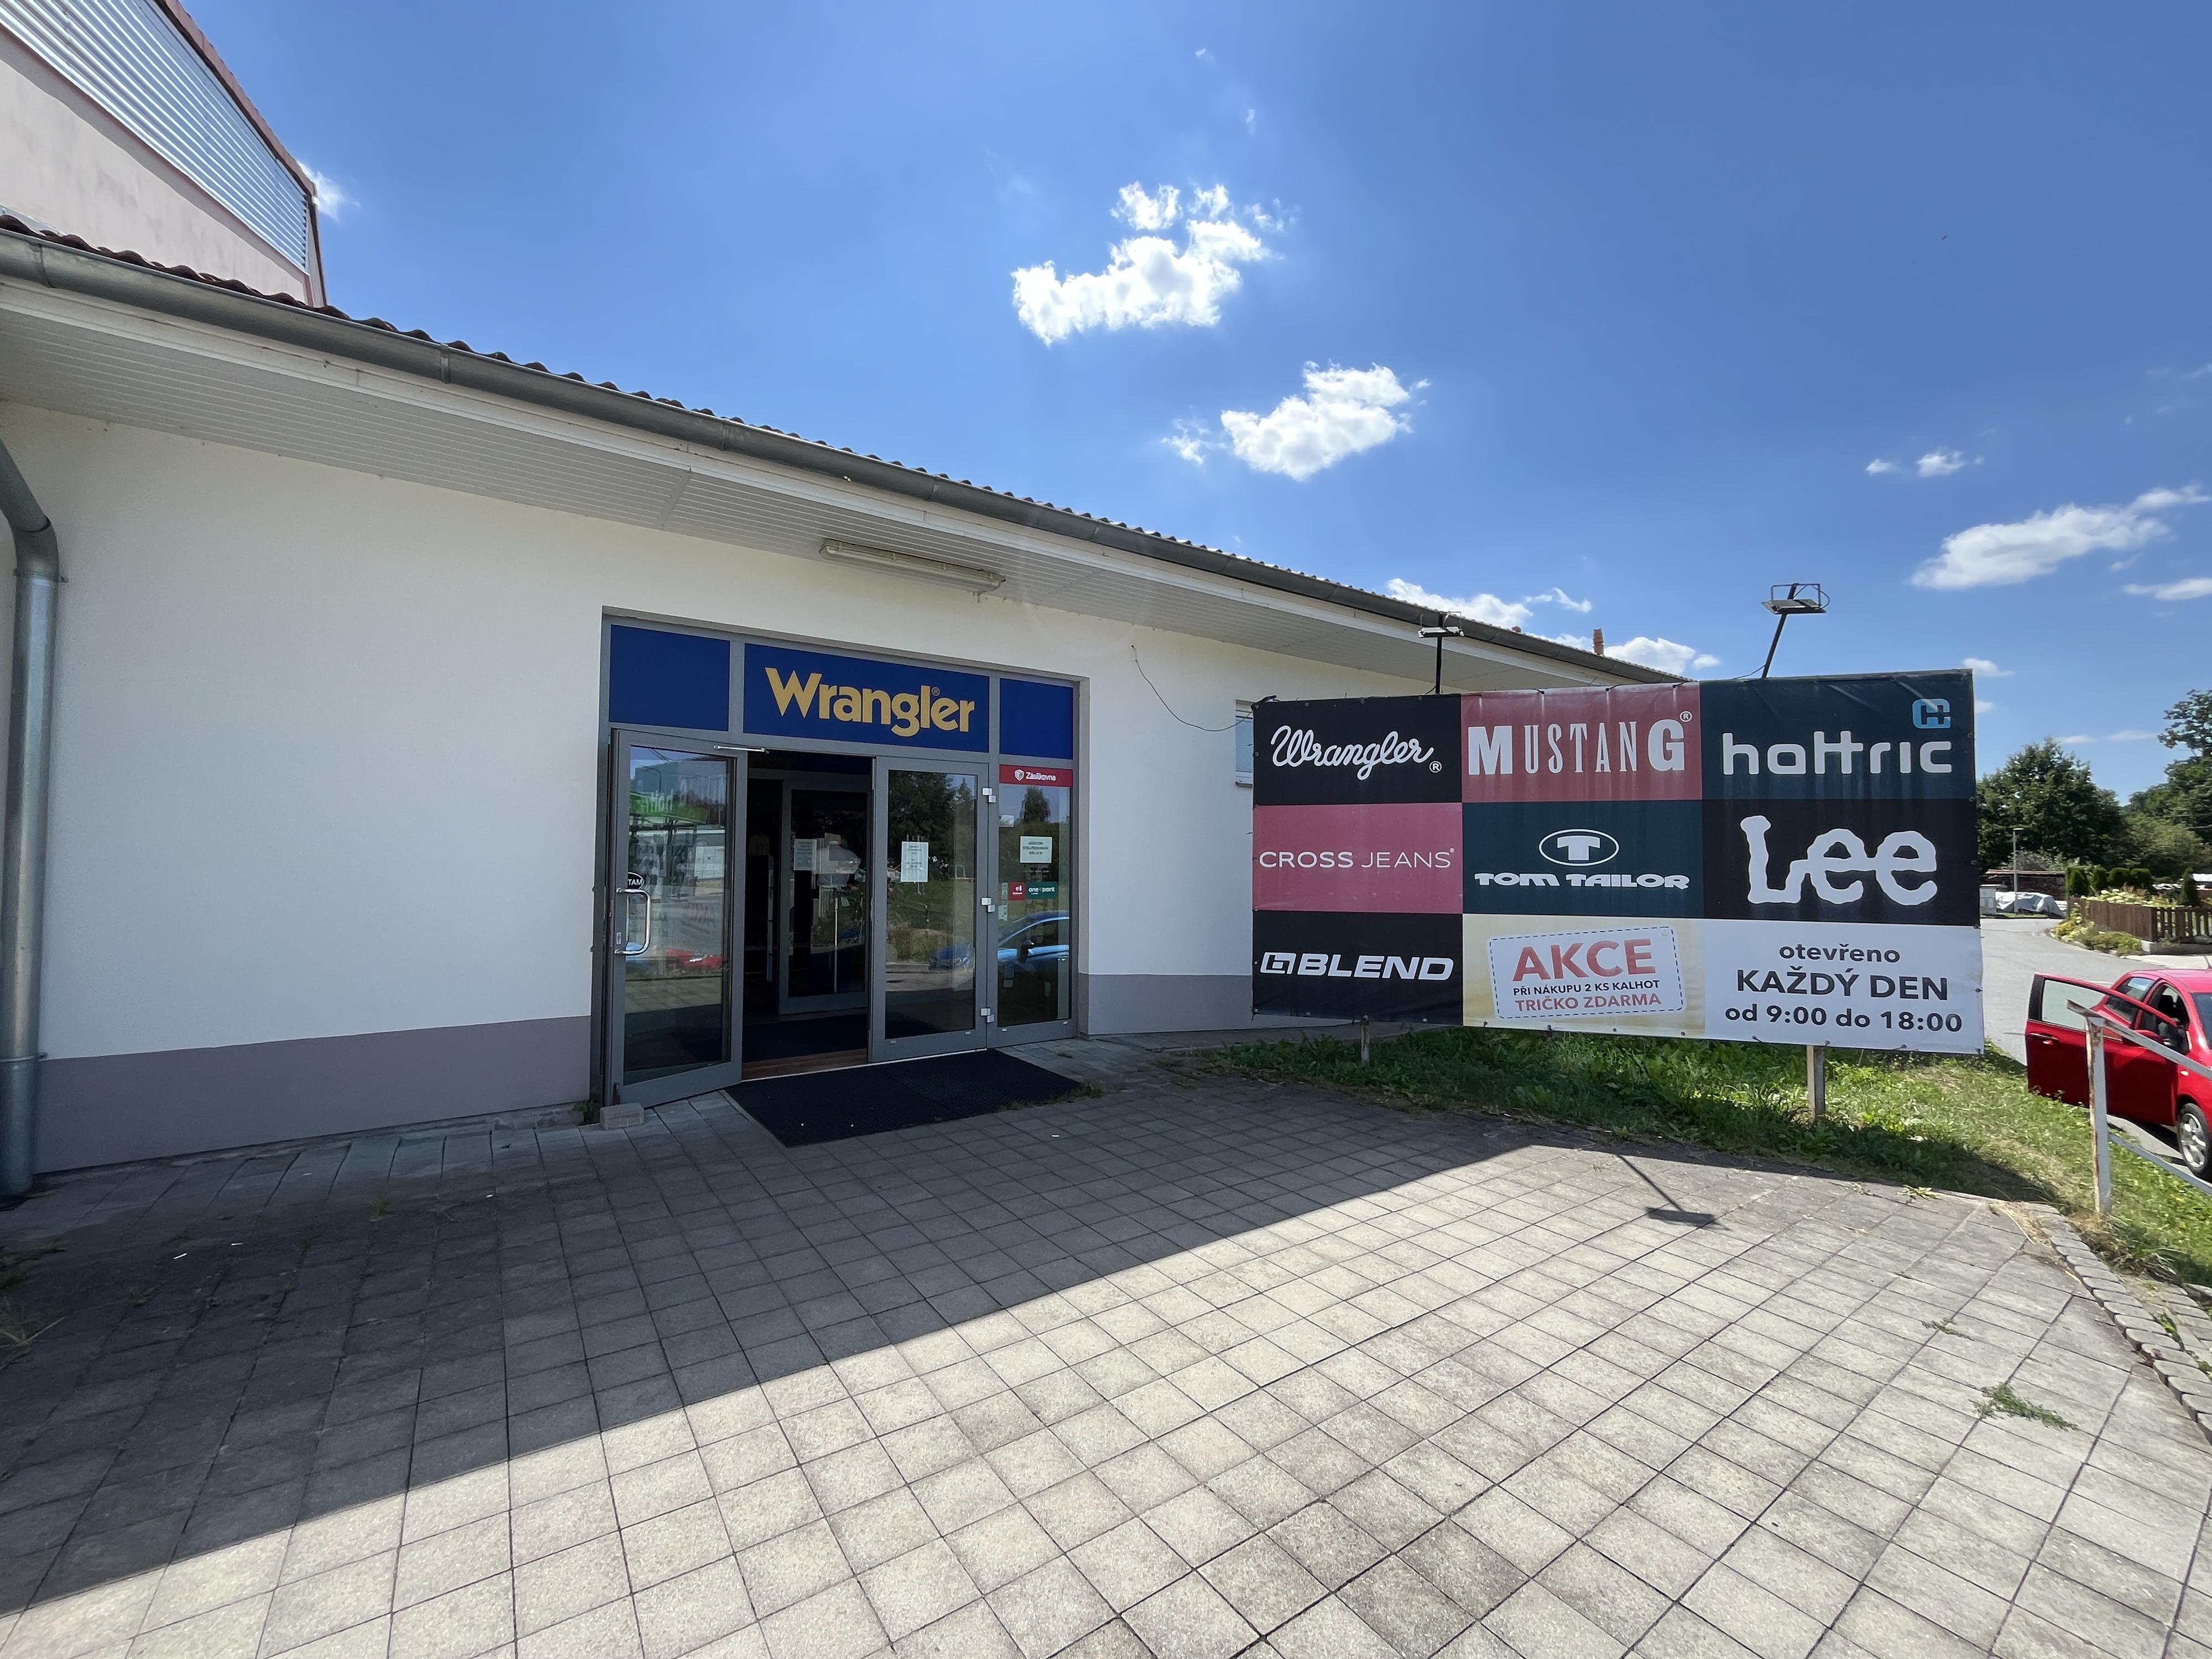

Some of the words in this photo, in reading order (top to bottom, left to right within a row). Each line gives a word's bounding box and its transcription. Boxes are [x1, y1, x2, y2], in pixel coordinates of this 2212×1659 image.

[765, 667, 975, 737] Wrangler
[1270, 725, 1434, 780] Wrangler
[1468, 719, 1684, 776] MUSTANG
[1723, 731, 1953, 775] hattric
[1259, 851, 1354, 868] CROSS
[1361, 852, 1451, 868] JEANS
[1740, 815, 1938, 906] Lee
[1474, 872, 1560, 886] TOM
[1566, 874, 1690, 890] TAILOR
[1297, 953, 1454, 980] BLEND
[1512, 938, 1656, 982] AKCE
[1779, 943, 1901, 963] otevřeno
[1514, 984, 1531, 995] PŘI
[1534, 984, 1582, 994] NÁKUPU
[1585, 983, 1592, 992] 2
[1595, 982, 1609, 991] KS
[1613, 980, 1660, 990] KALHOT
[1737, 966, 1860, 997] KAŽDÝ
[1870, 974, 1948, 1000] DEN
[1515, 995, 1578, 1011] TRIČKO
[1583, 993, 1662, 1009] ZDARMA
[1725, 1004, 1757, 1021] od
[1766, 1005, 1827, 1025] 9:00
[1835, 1009, 1870, 1027] do
[1881, 1011, 1962, 1032] 18:00
